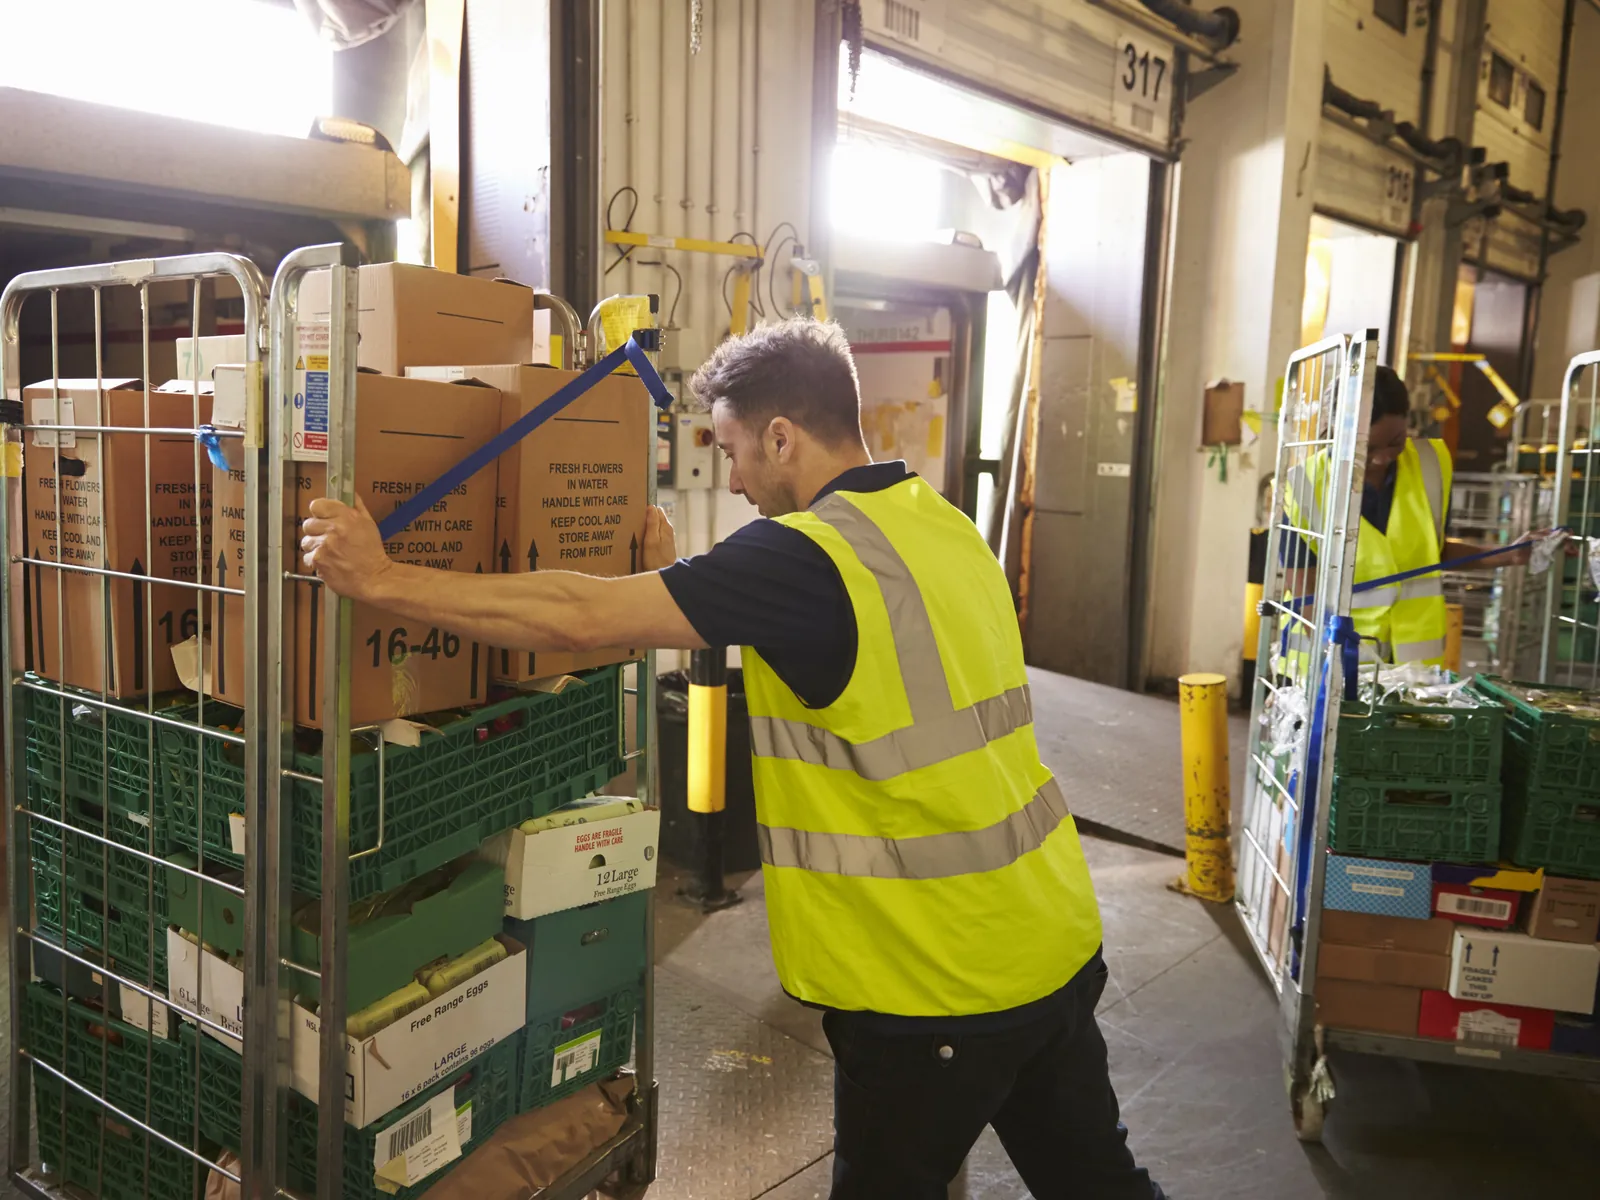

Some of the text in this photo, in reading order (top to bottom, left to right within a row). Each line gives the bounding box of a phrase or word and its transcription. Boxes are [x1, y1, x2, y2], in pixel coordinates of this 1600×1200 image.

[1121, 42, 1166, 102] 317
[549, 463, 623, 474] FRESH FLOWERS
[65, 480, 100, 493] FLOWERS
[155, 483, 196, 494] FRESH
[372, 481, 412, 494] FRESH
[567, 479, 608, 490] IN WATER
[63, 496, 88, 508] WATER
[179, 498, 191, 510] IN
[542, 495, 629, 509] HANDLE WITH CARE
[67, 513, 85, 525] WITH
[414, 520, 442, 532] WITH
[444, 519, 473, 531] CARE
[551, 514, 621, 528] KEEP COOL AND
[63, 531, 84, 544] COOL
[86, 536, 101, 547] AND
[159, 536, 191, 547] KEEP
[558, 530, 615, 544] STORE AWAY
[75, 547, 96, 561] AWAY
[407, 542, 438, 554] COOL
[440, 541, 463, 553] AND
[560, 545, 613, 560] FROM FRUIT
[424, 558, 454, 569] AWAY
[576, 827, 623, 844] EGGS ARE FRAGILE
[574, 835, 624, 853] HANDLE WITH CARE
[597, 867, 639, 886] 12 Large
[593, 882, 637, 898] Free Range Eggs
[1462, 966, 1498, 976] FRAGILE
[1468, 983, 1488, 991] THIS
[1461, 990, 1479, 998] WAY
[410, 980, 489, 1032] Free Range Eggs
[434, 1043, 468, 1071] LARGE
[401, 1091, 410, 1102] 16
[416, 1083, 422, 1091] 6
[422, 1072, 440, 1087] pack
[440, 1054, 469, 1077] contains
[470, 1048, 478, 1058] 96
[479, 1037, 495, 1052] eggs
